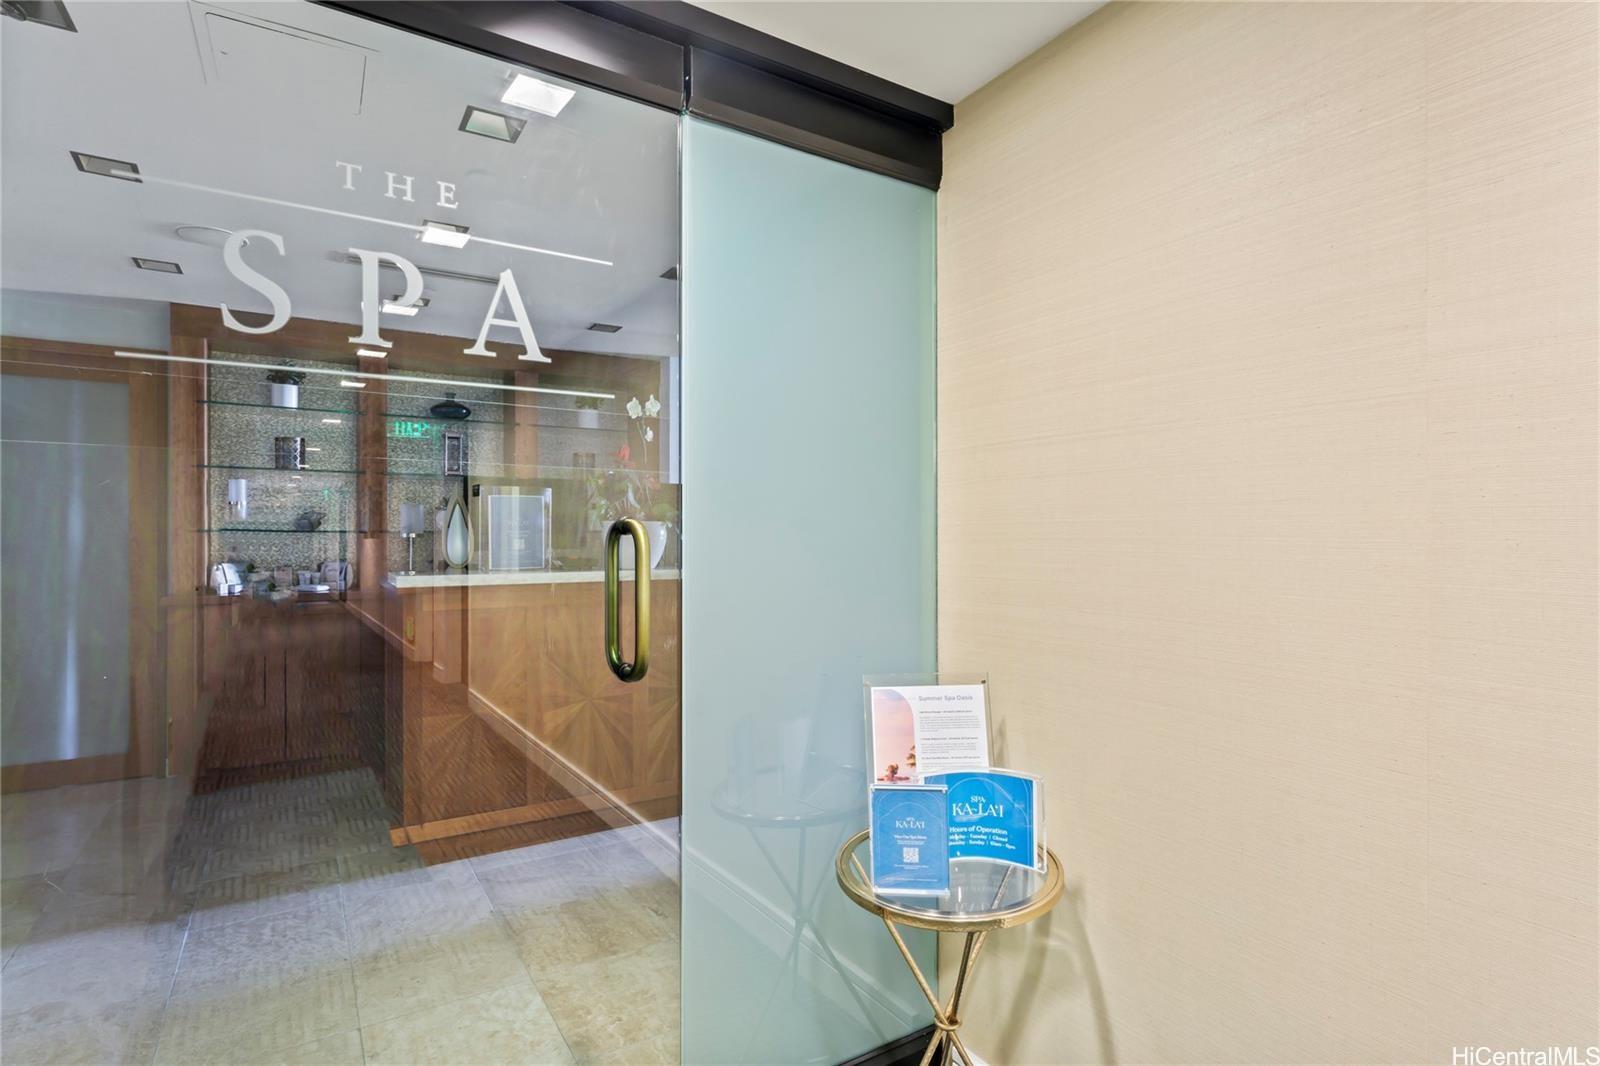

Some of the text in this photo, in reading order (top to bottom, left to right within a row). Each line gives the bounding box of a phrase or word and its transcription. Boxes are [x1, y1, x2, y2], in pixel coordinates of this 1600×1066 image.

[336, 160, 459, 209] THE
[220, 228, 552, 363] SPA
[970, 795, 986, 803] SPA
[976, 826, 1008, 835] Operation
